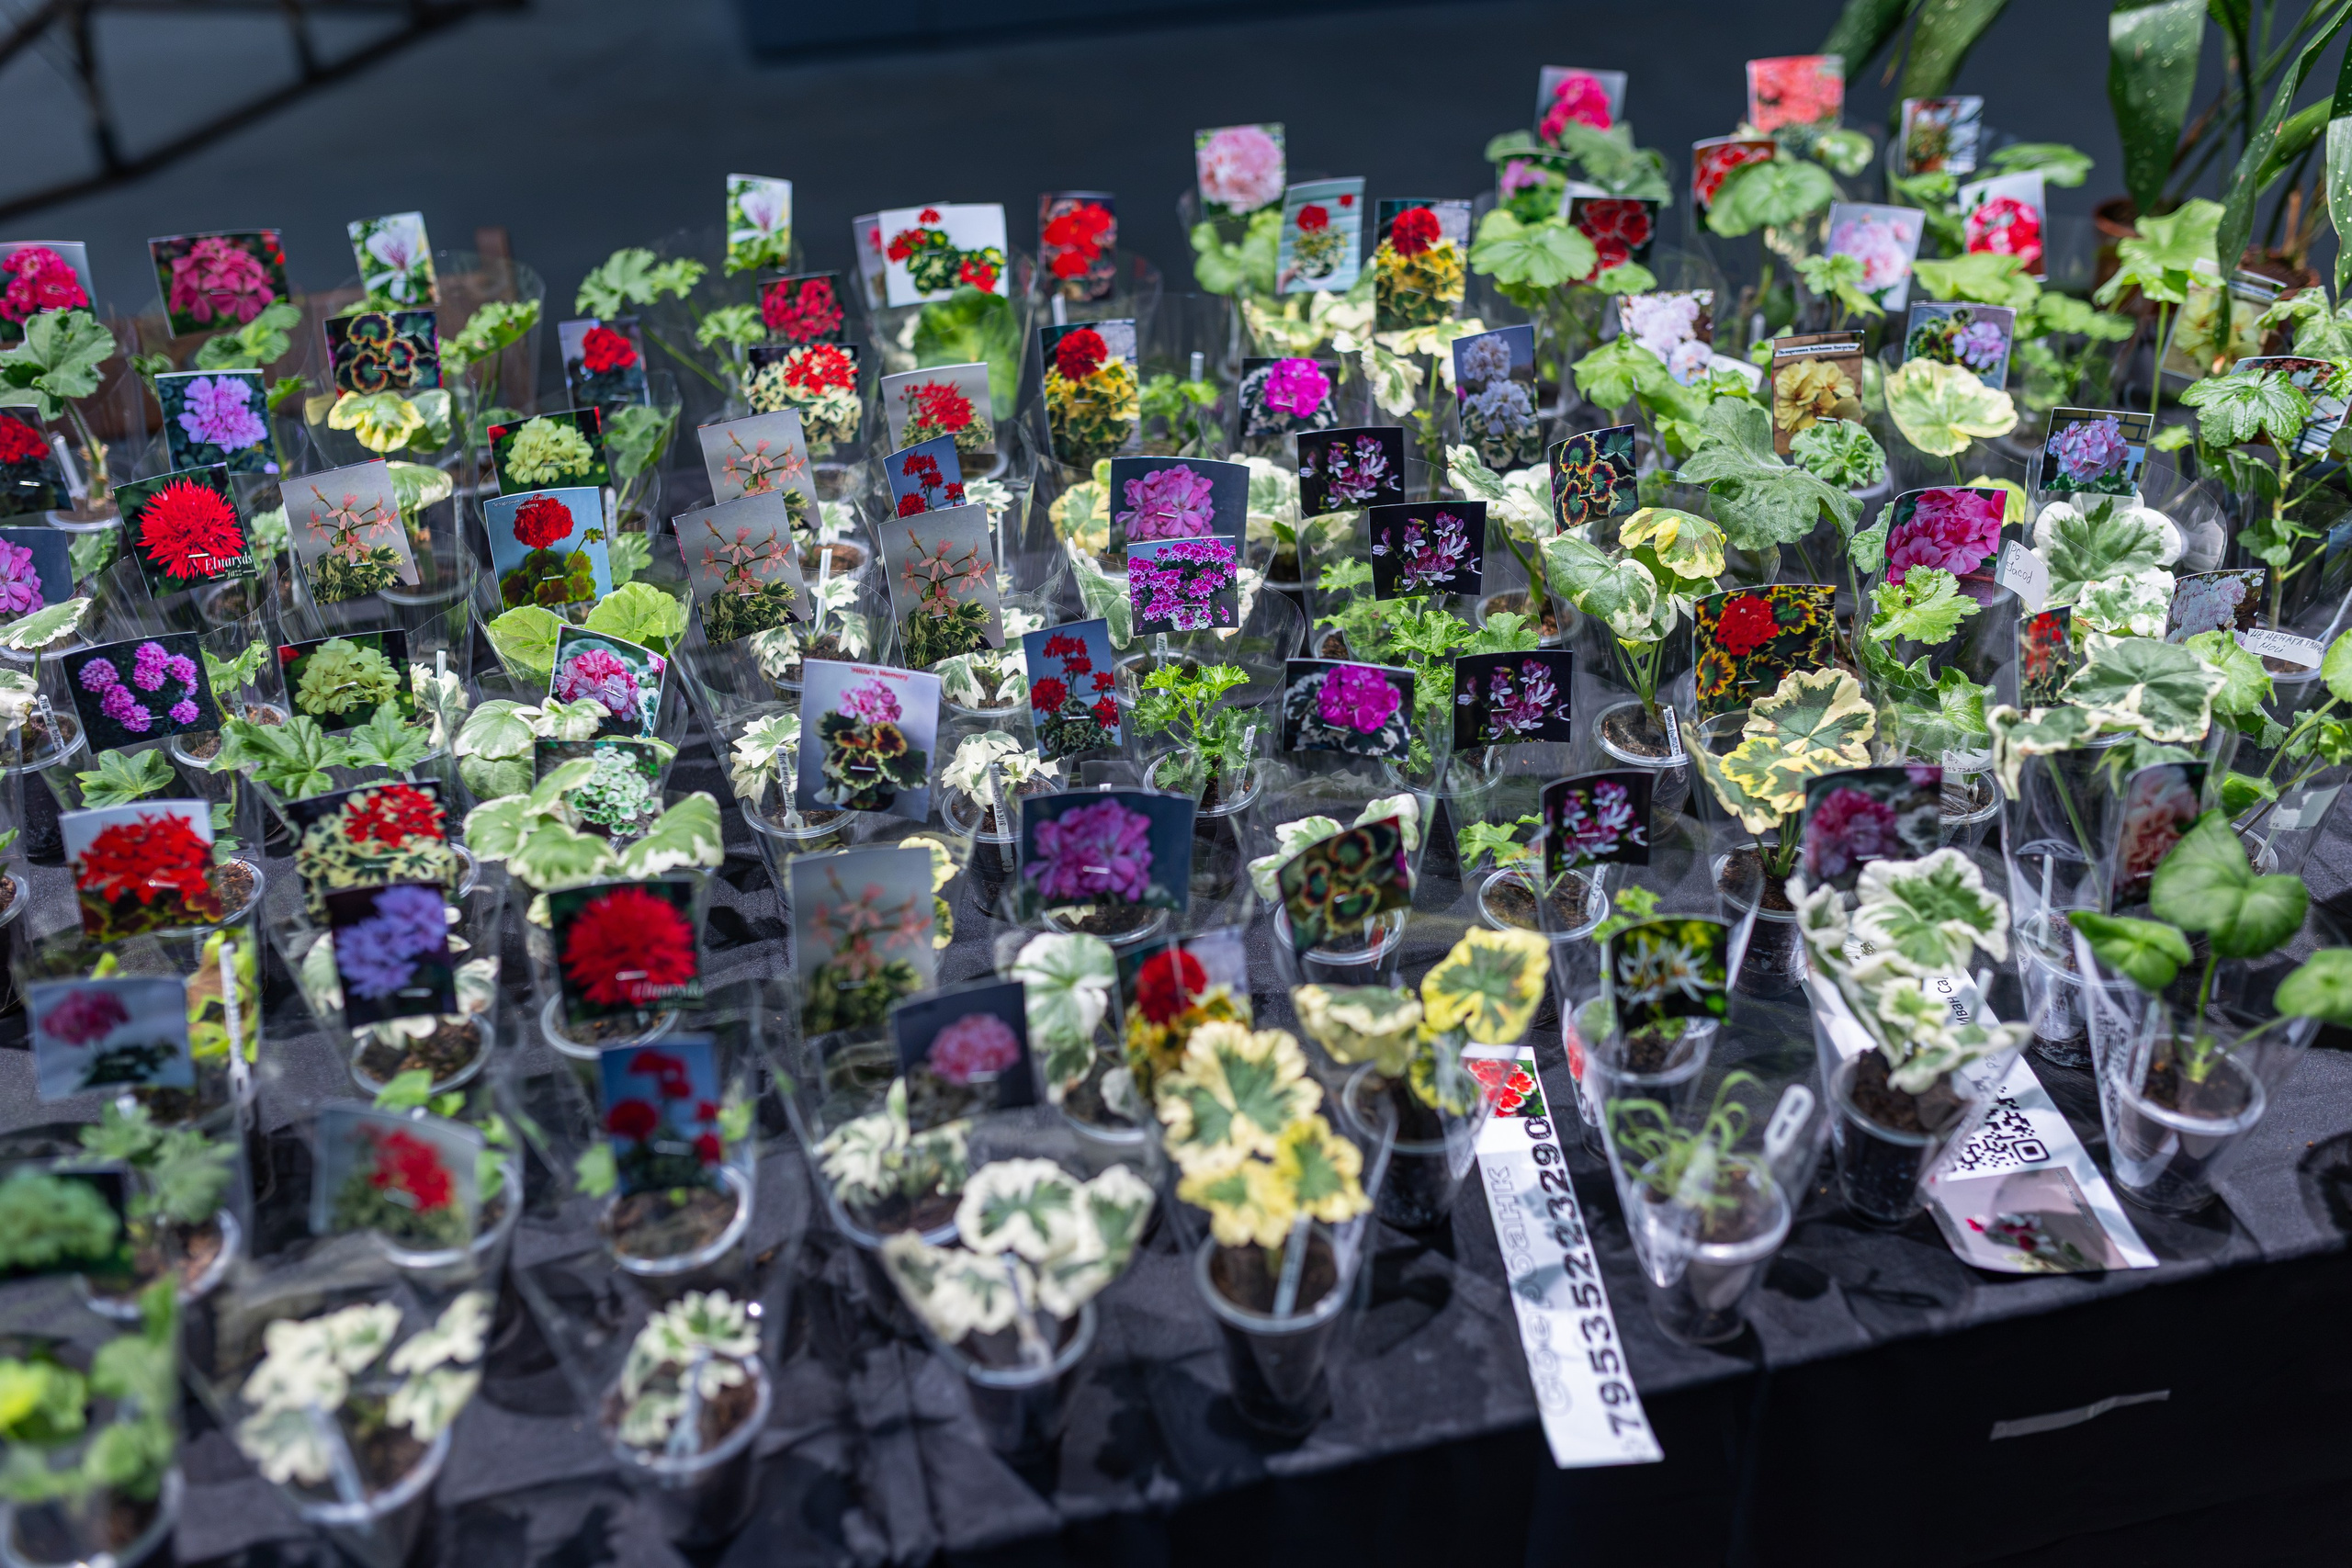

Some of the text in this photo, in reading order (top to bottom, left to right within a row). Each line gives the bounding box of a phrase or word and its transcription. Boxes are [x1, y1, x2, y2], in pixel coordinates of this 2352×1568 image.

[205, 551, 253, 571] Elnaryds
[1947, 995, 1972, 1026] Иван
[1522, 1114, 1643, 1439] 79535223290
